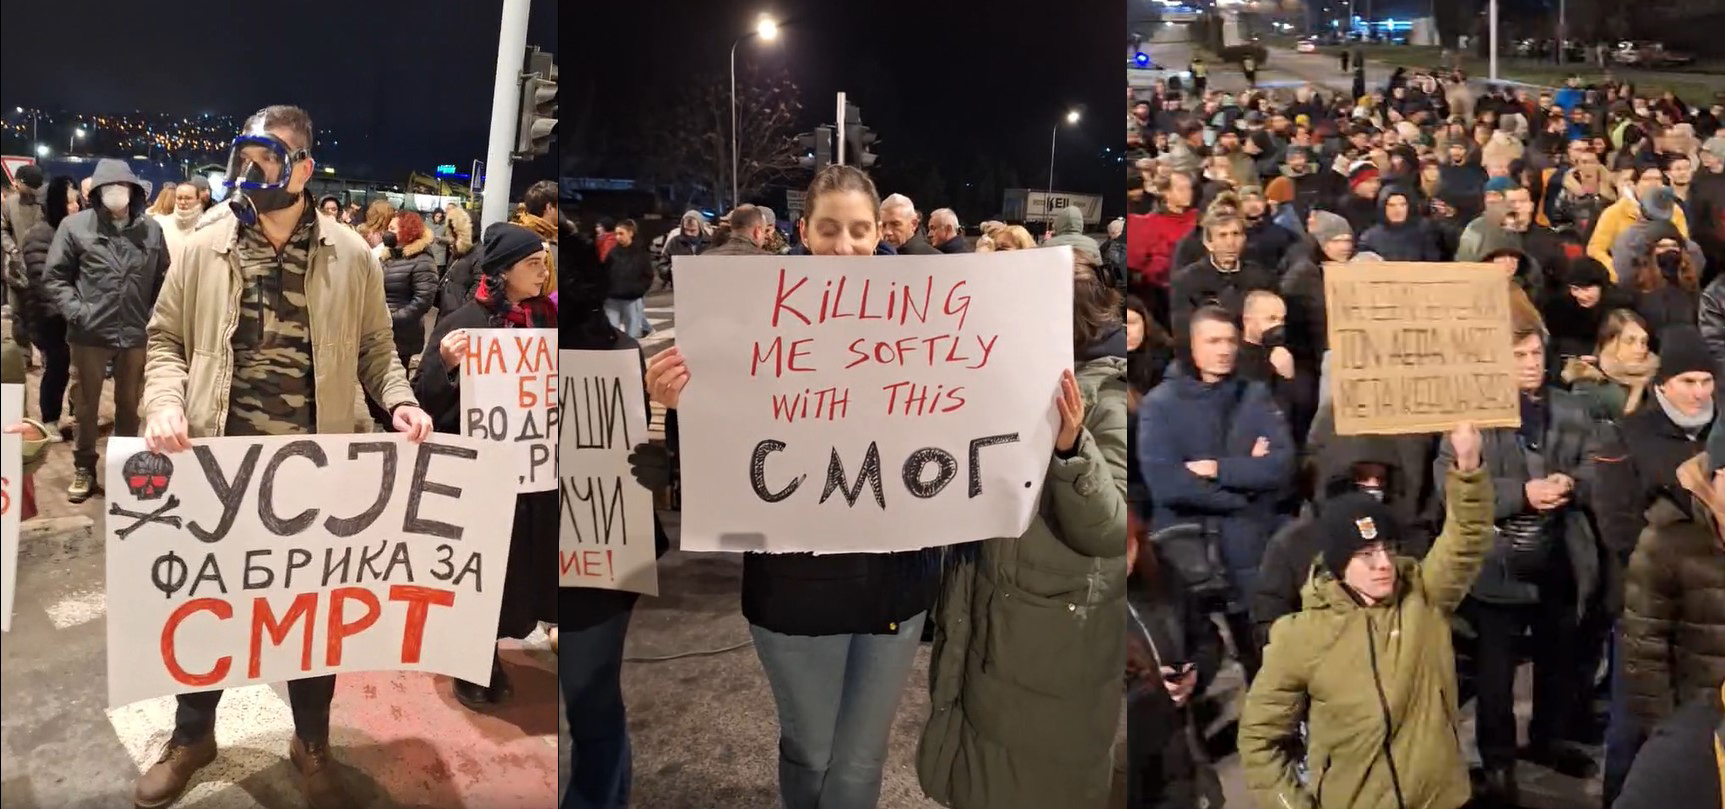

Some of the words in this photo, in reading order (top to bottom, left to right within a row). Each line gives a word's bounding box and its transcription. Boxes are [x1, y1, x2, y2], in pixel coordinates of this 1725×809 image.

[465, 336, 507, 376] НА
[514, 336, 558, 374] ХА
[751, 336, 816, 377] ME
[845, 334, 998, 369] SOFTLY
[467, 405, 508, 441] ВО
[186, 440, 479, 543] УСЈЕ
[151, 539, 415, 599] ФАБРИКА
[429, 543, 482, 593] ЗА
[160, 584, 455, 687] СМРТ
